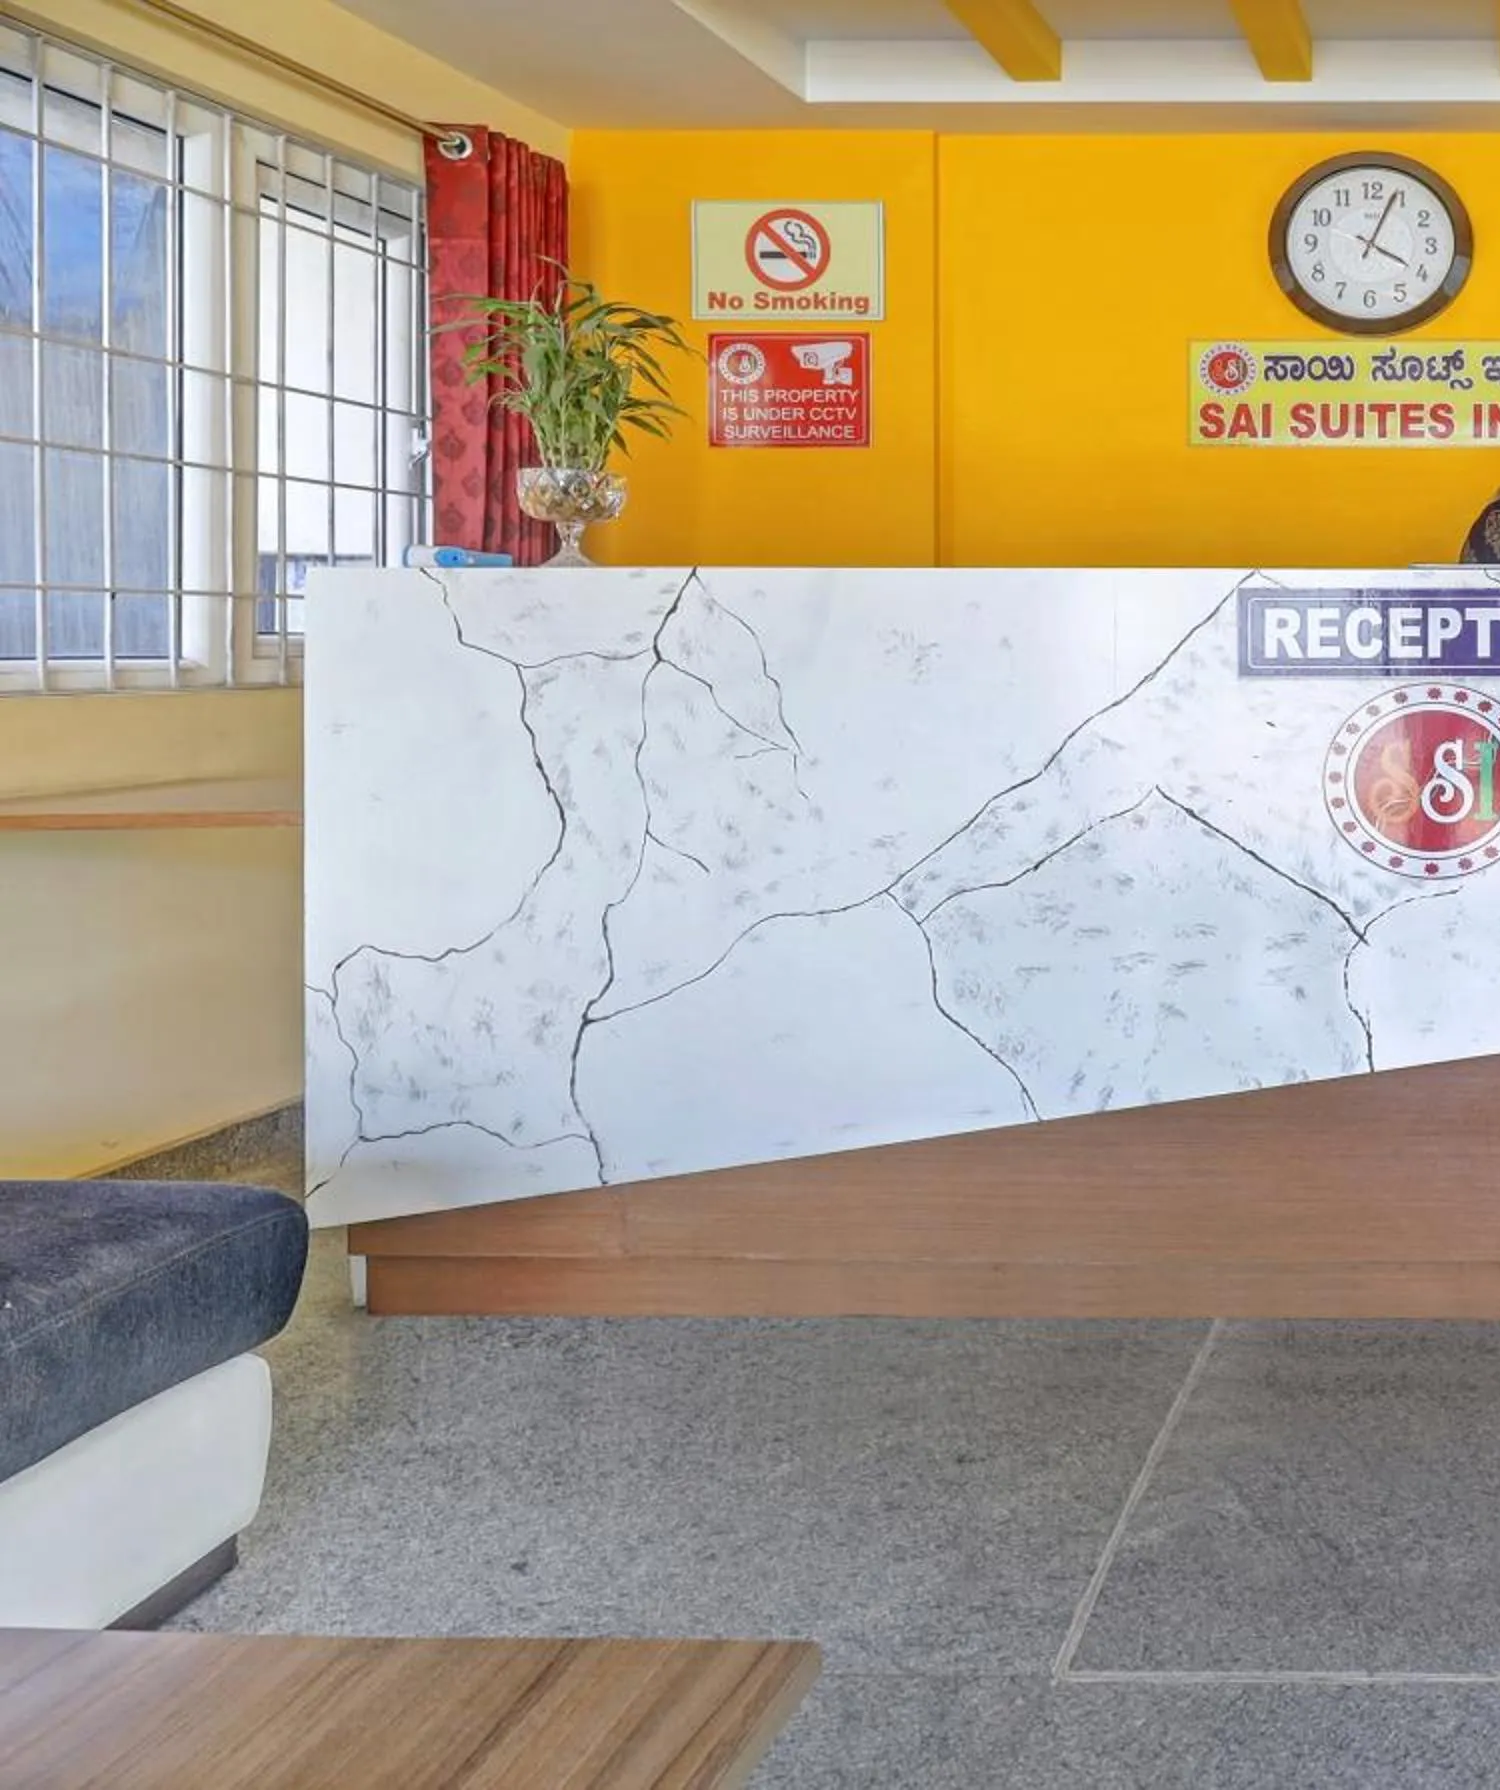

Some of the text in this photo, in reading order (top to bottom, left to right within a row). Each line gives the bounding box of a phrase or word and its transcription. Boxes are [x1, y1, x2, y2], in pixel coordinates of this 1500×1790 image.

[1334, 188, 1350, 207] 11
[1362, 181, 1384, 200] 12
[1398, 190, 1406, 209] 1
[1312, 208, 1332, 227] 10
[1417, 209, 1430, 228] 2
[1304, 234, 1318, 253] 9
[1425, 237, 1438, 255] 3
[1311, 263, 1325, 282] 8
[1416, 264, 1428, 282] 4
[1335, 281, 1347, 300] 7
[1363, 289, 1377, 309] 6
[1393, 283, 1407, 303] 5
[707, 291, 870, 314] No Smoking
[1263, 353, 1356, 382] ಸಾಯಿ
[720, 389, 859, 403] THIS PROPERTY
[722, 407, 857, 421] IS UNDER CCTV
[1199, 402, 1272, 439] SAI
[1290, 402, 1455, 439] SUITES
[724, 425, 856, 439] SURVEILLANCE
